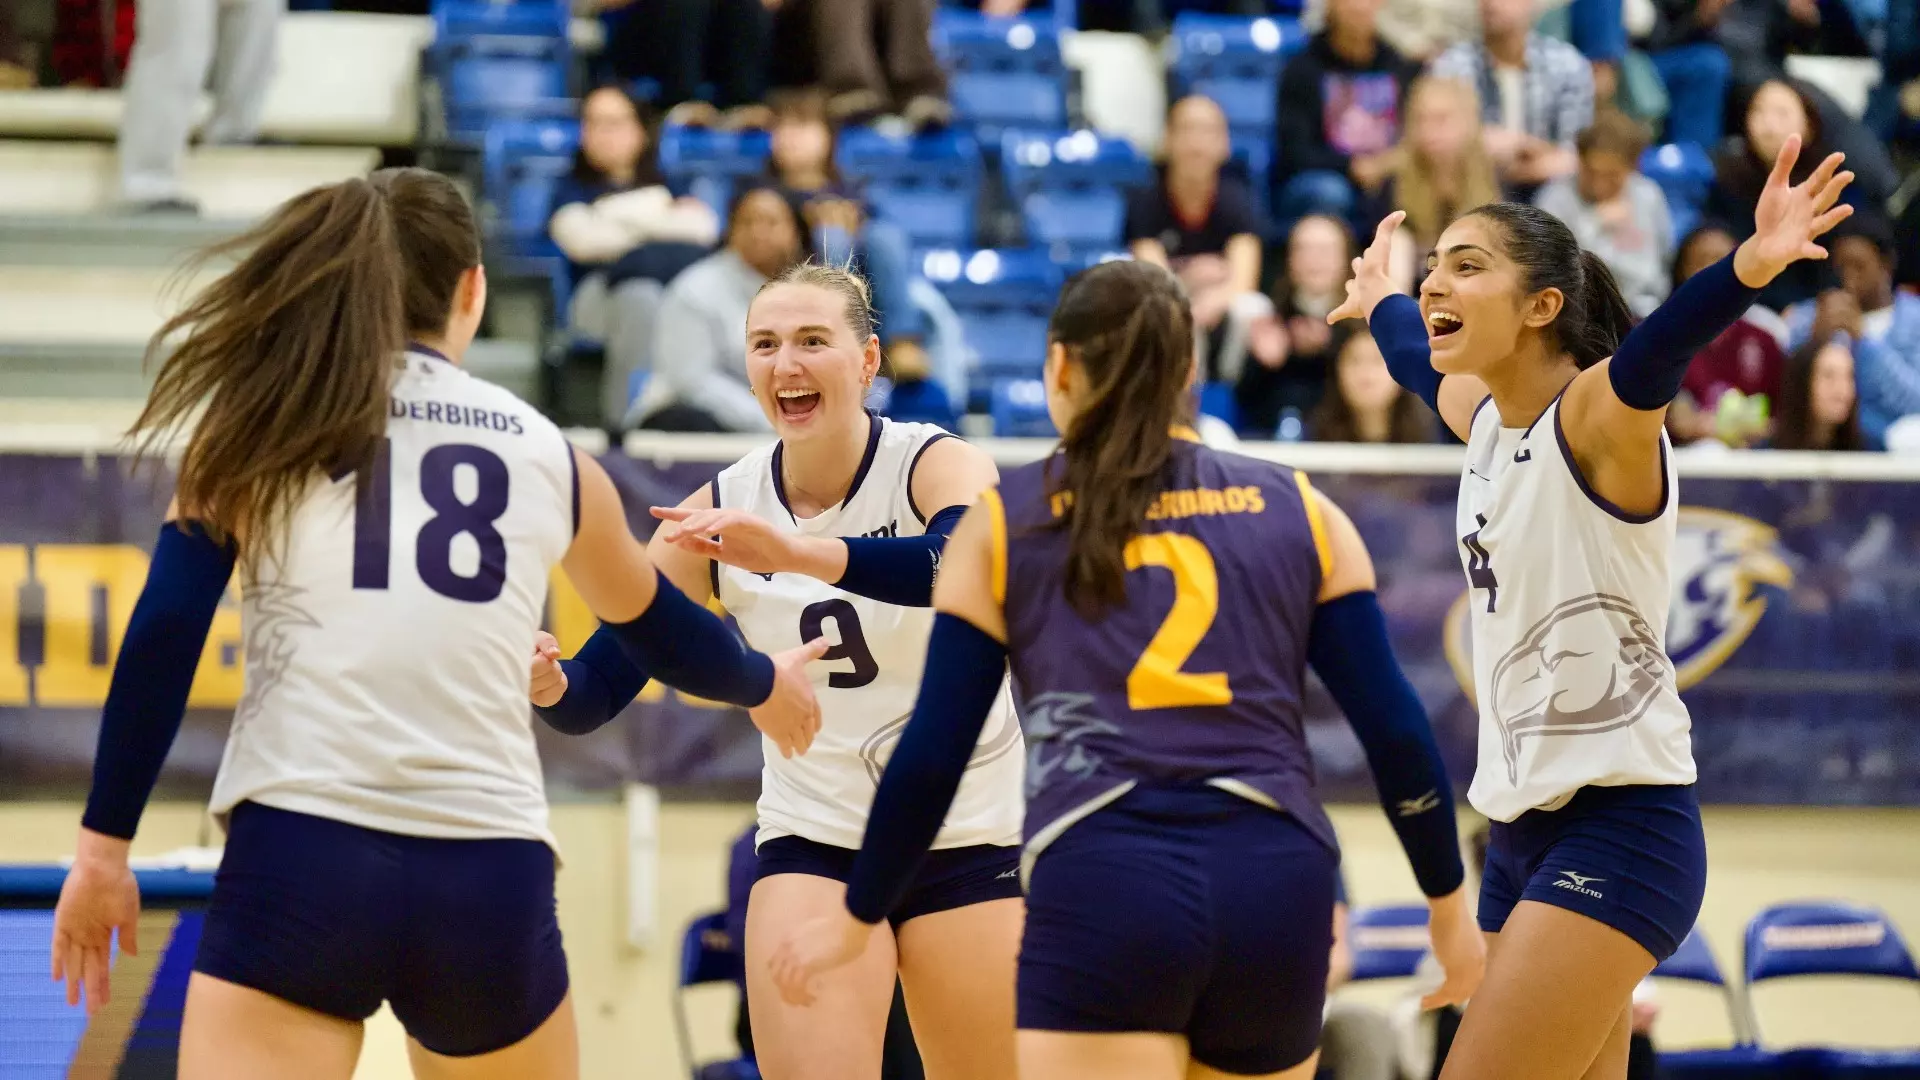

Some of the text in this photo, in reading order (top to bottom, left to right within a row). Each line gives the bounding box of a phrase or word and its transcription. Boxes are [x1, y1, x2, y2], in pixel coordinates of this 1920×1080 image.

[390, 397, 524, 435] DERBIRDS
[328, 436, 510, 603] 18
[1462, 512, 1499, 614] 4
[799, 598, 879, 688] 9
[1123, 531, 1233, 711] 2
[1552, 879, 1603, 900] MIZUNO
